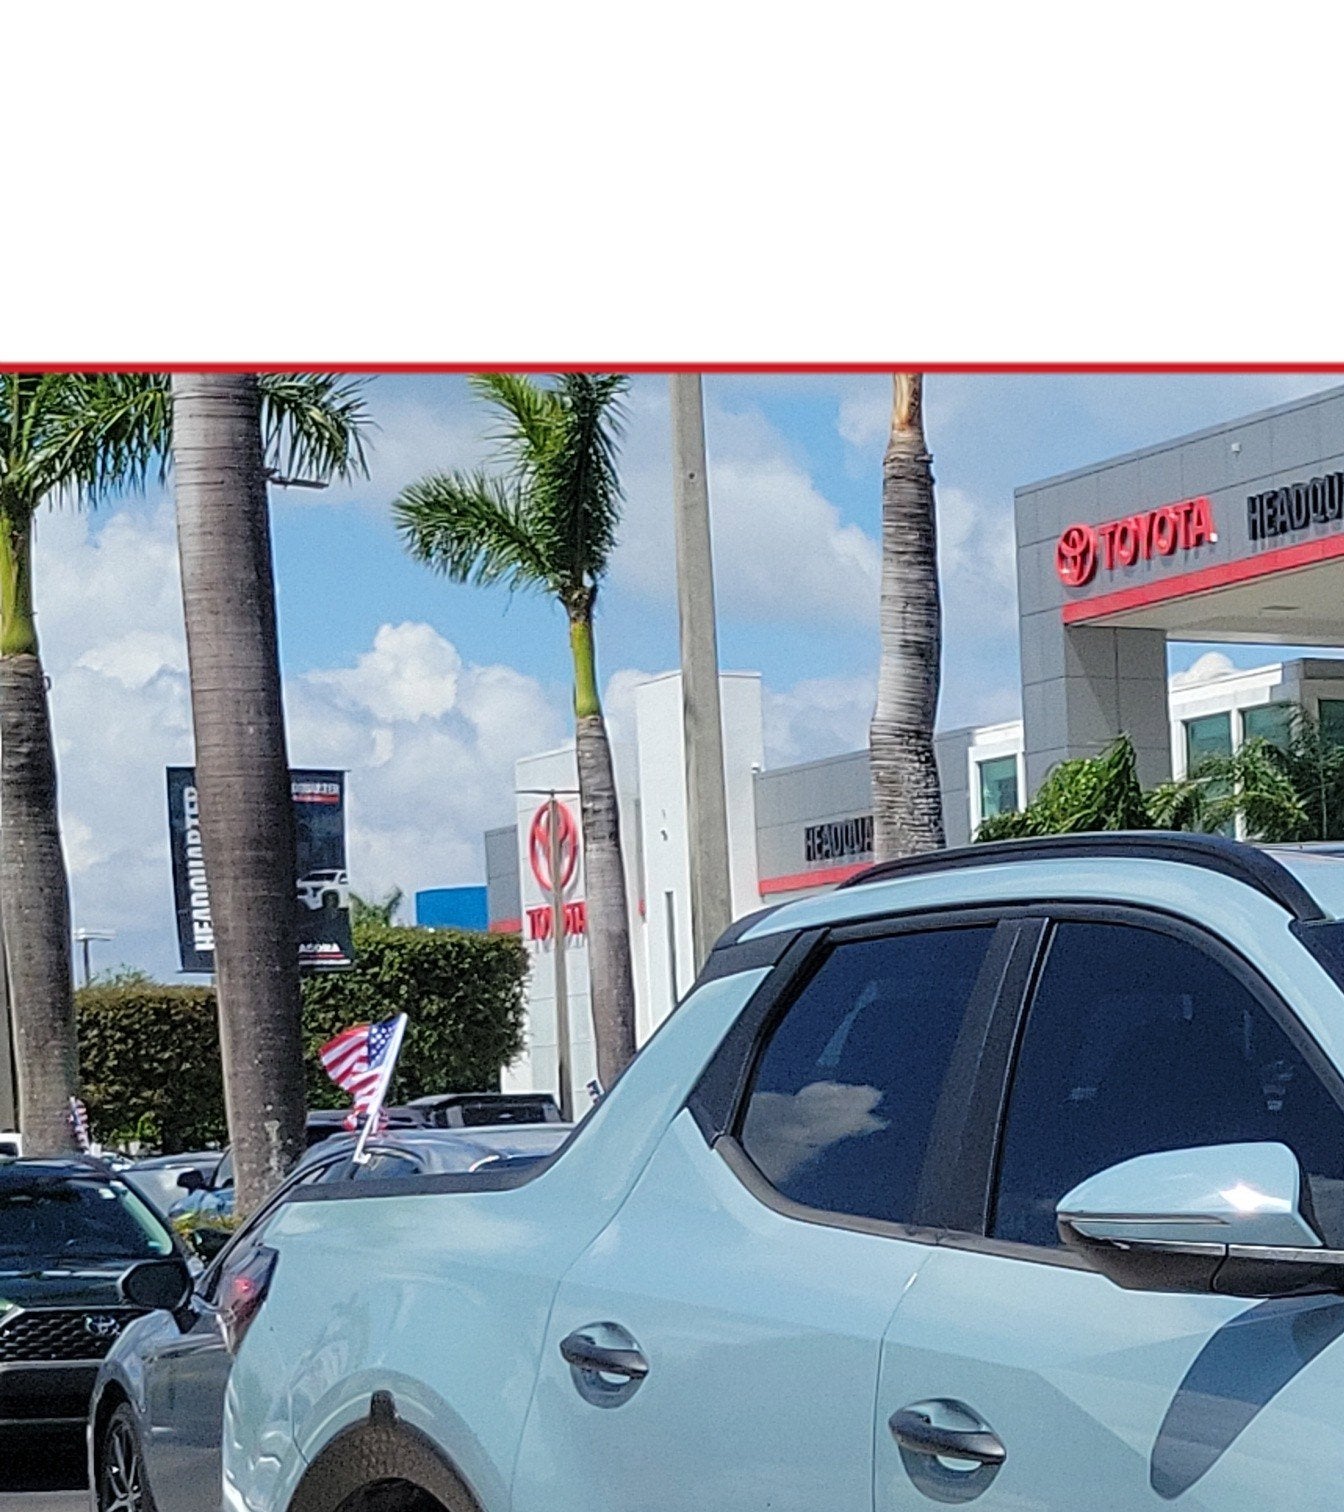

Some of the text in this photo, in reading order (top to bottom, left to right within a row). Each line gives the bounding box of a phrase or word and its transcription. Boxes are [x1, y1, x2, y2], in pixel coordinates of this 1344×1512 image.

[1100, 496, 1217, 571] TOYOTA
[804, 814, 875, 861] HEADQUA
[526, 901, 587, 940] TOOTA
